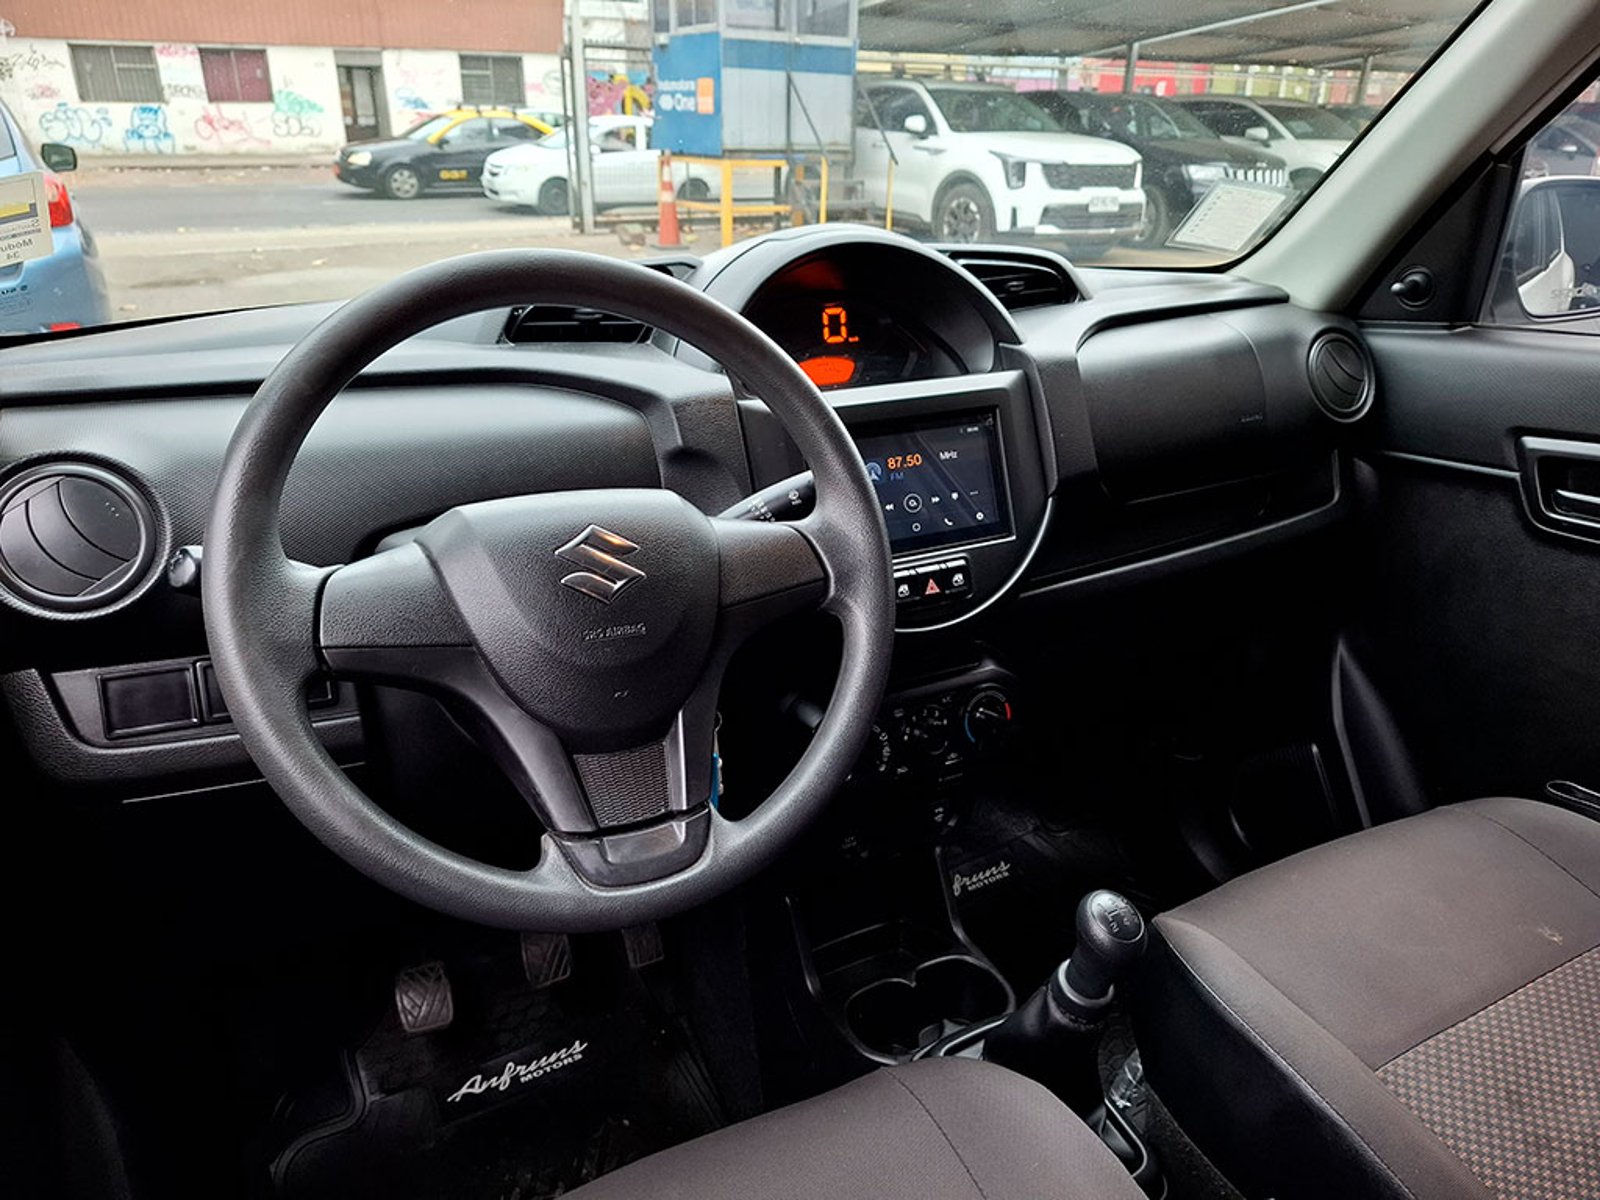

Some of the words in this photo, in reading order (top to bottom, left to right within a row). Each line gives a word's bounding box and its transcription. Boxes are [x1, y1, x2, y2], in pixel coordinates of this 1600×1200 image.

[822, 306, 847, 344] 0
[887, 453, 922, 470] 87.50
[940, 451, 958, 460] MHz
[953, 860, 1010, 896] fruns
[967, 871, 1009, 890] MOTORS
[447, 1040, 588, 1102] Anfruns
[520, 1053, 583, 1083] MOTORS
